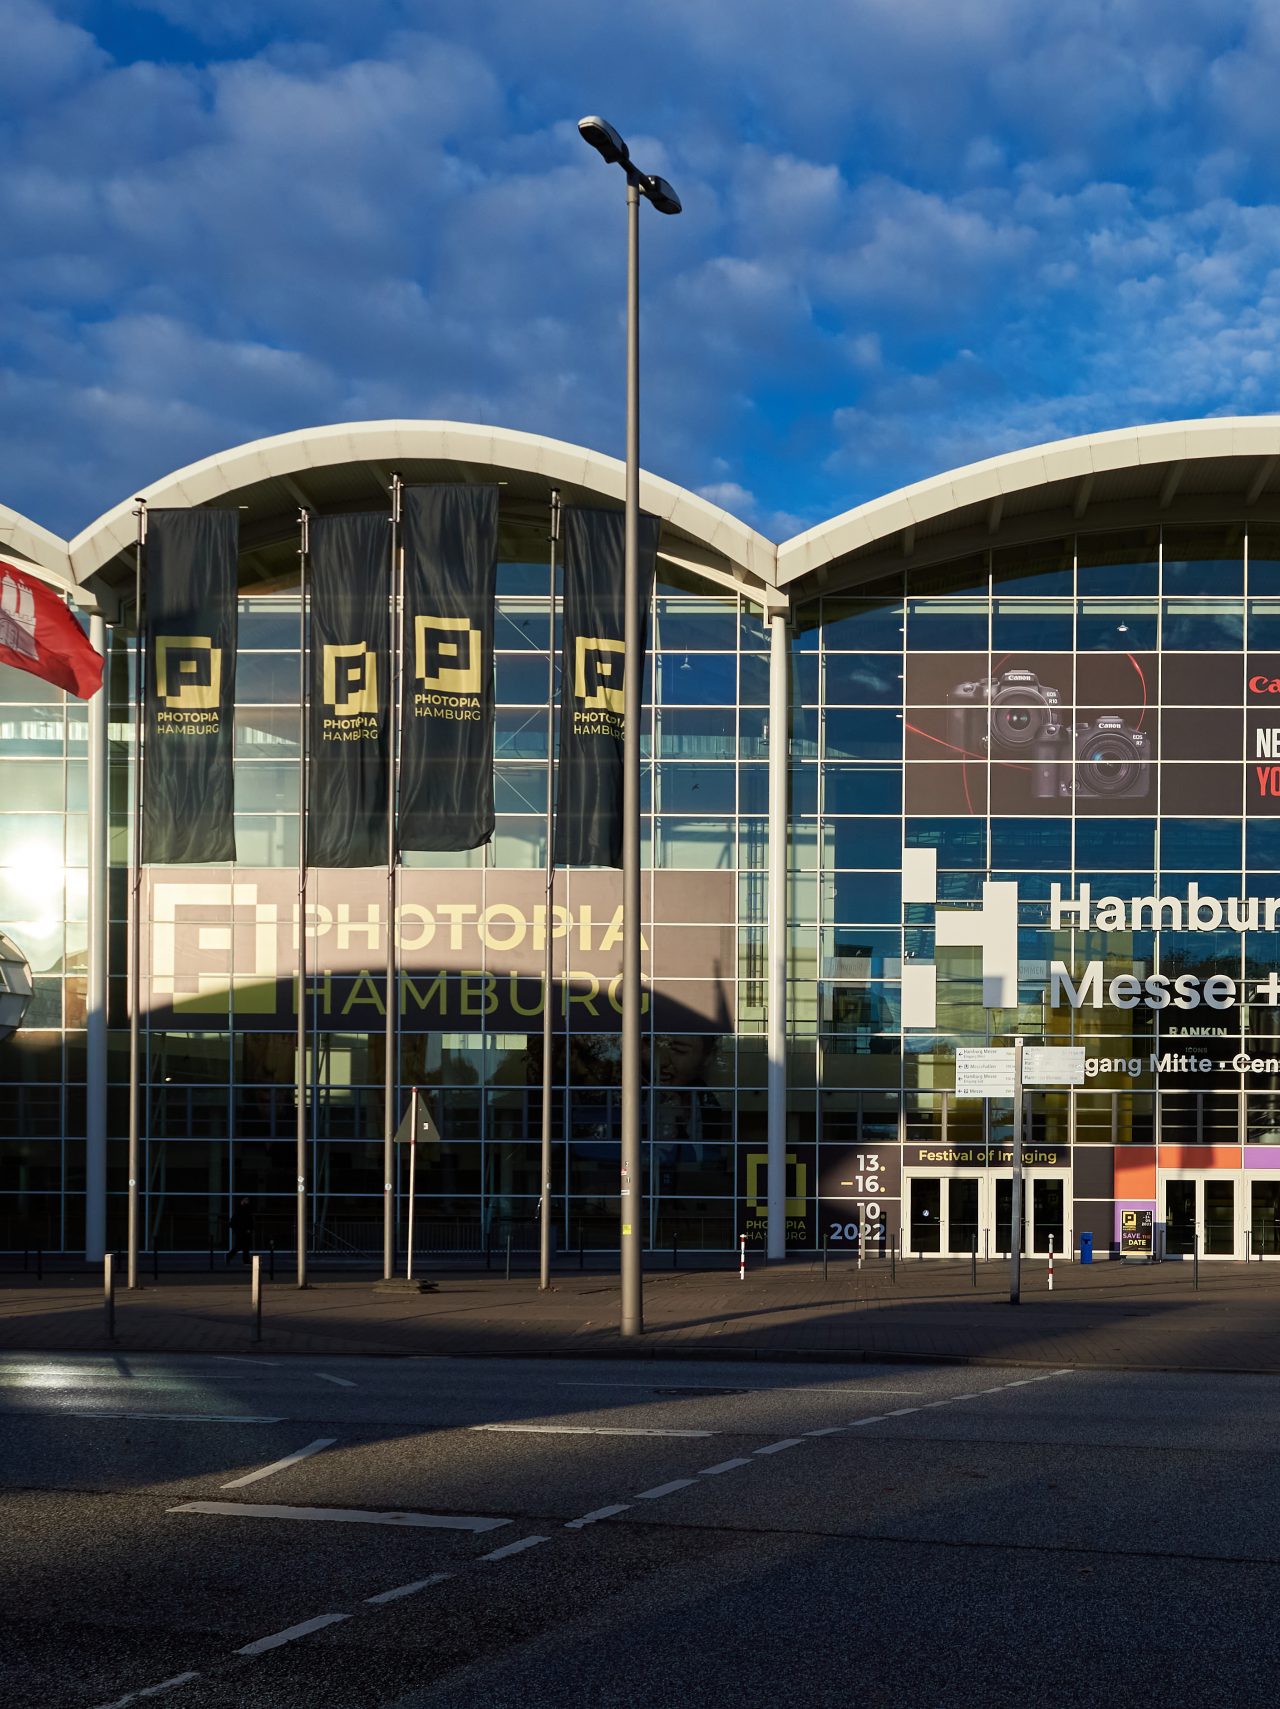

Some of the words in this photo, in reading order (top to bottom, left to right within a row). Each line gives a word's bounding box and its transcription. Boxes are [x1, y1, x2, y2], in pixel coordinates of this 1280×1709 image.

[414, 694, 481, 708] PHOTOPIA
[157, 711, 219, 723] PHOTOPIA
[414, 707, 481, 721] HAMBURG
[157, 723, 219, 735] HAMBURG
[323, 716, 378, 729] PHOTOPIA
[323, 729, 378, 741] HAMBURG
[293, 903, 649, 951] PHOTOPIA
[1050, 960, 1237, 1010] Messe
[293, 969, 650, 1017] HAMBURG
[1168, 1026, 1228, 1036] RANKIN
[1084, 1055, 1142, 1077] gang
[1150, 1053, 1212, 1073] Mitte
[856, 1154, 886, 1172] 13.
[919, 1149, 972, 1161] Festival
[977, 1149, 994, 1161] of
[998, 1149, 1057, 1165] Imging
[746, 1220, 806, 1230] PHOPIA
[829, 1222, 886, 1241] 2022
